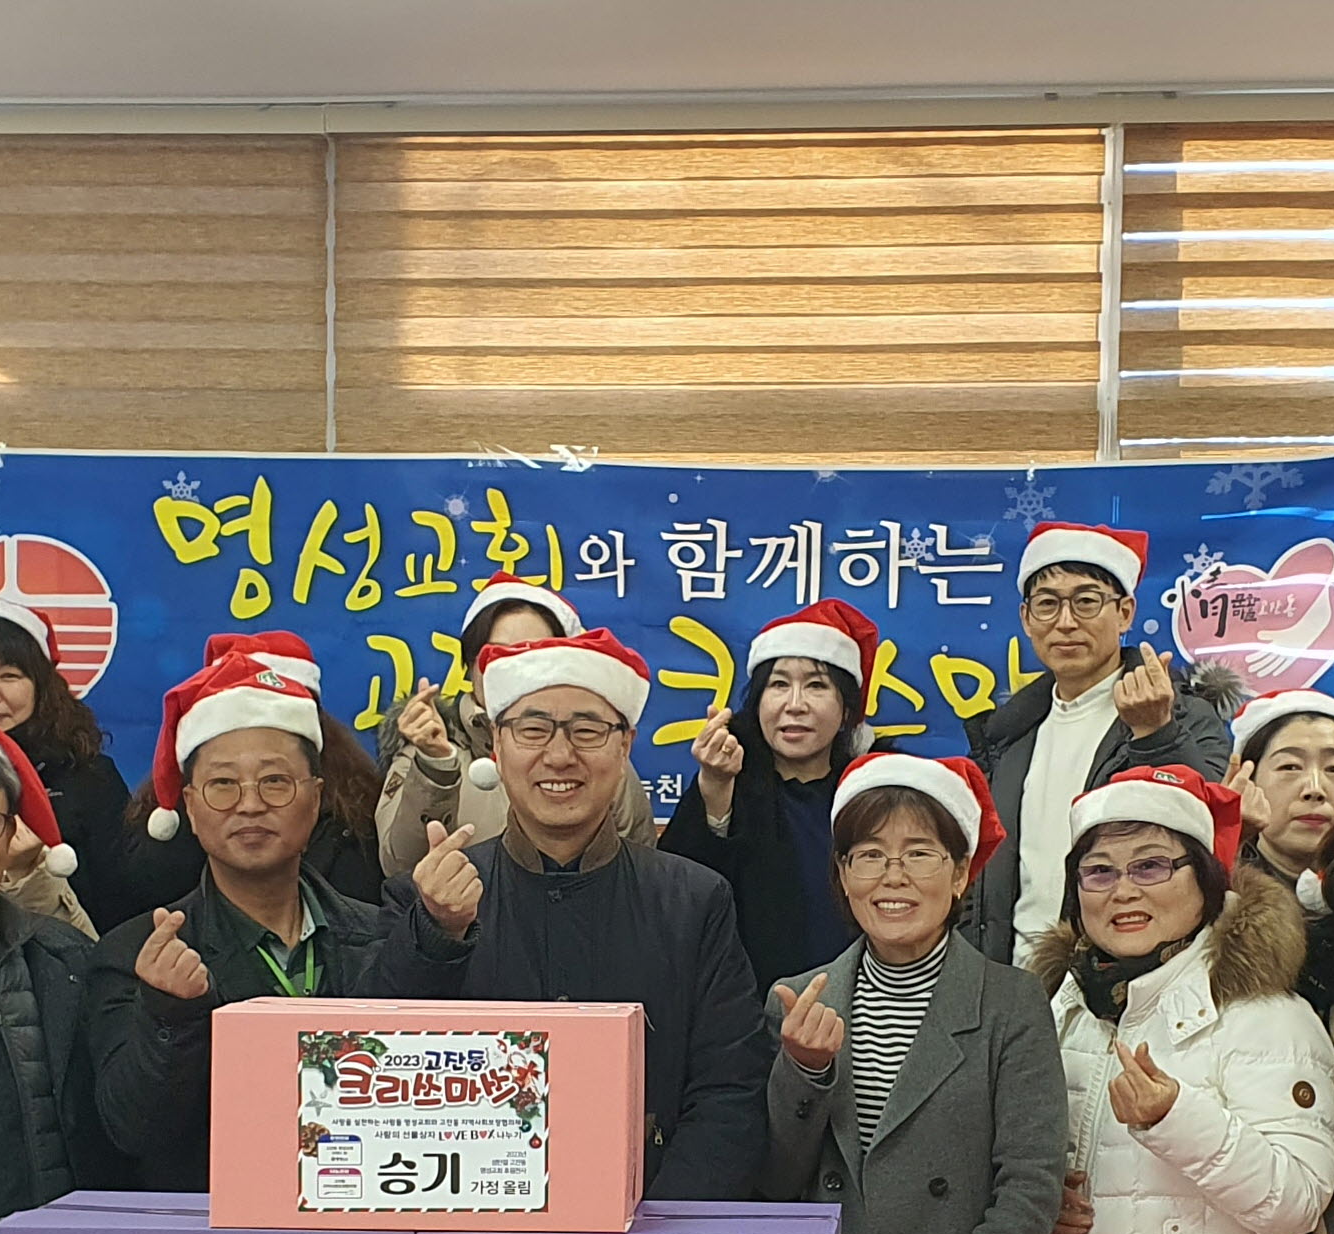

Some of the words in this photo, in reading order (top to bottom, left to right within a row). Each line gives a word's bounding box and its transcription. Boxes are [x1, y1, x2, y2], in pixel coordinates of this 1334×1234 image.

[153, 475, 636, 619] 명성교회와
[660, 518, 1003, 609] 함께하는
[384, 1055, 420, 1066] 2023
[424, 1050, 487, 1070] 고잔동
[377, 1152, 459, 1194] 승기
[471, 1180, 499, 1195] 가정
[503, 1180, 531, 1195] 올림
